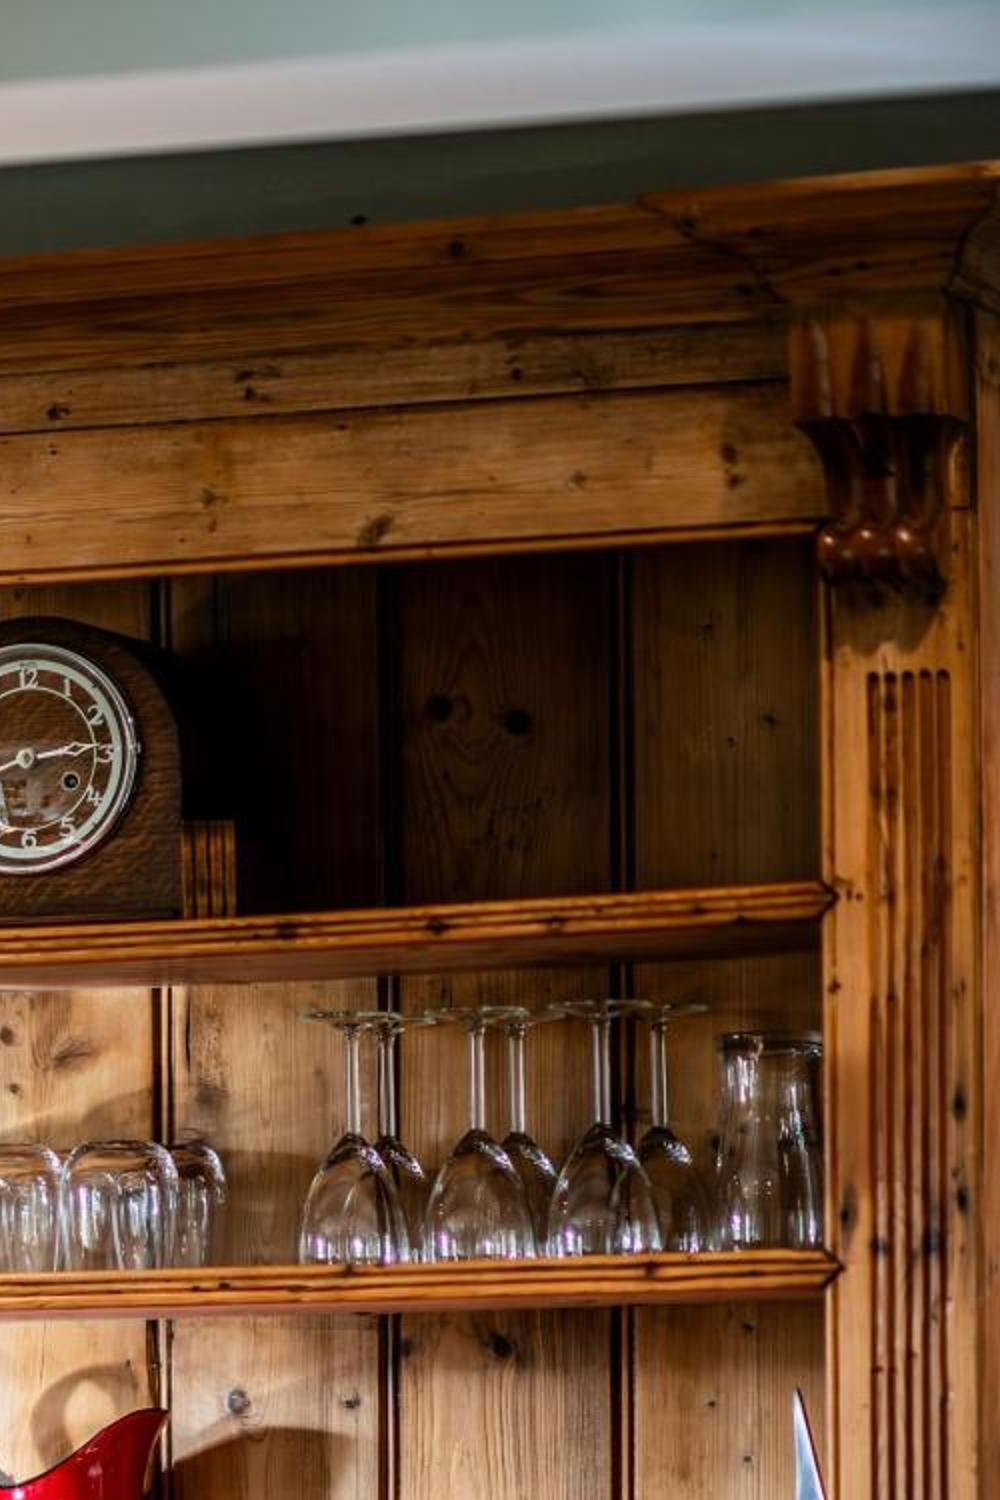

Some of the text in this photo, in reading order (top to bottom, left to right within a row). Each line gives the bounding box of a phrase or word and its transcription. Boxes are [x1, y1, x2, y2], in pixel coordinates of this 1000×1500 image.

[20, 667, 39, 689] 12
[64, 678, 72, 697] 1
[87, 705, 104, 725] 2
[96, 743, 114, 764] 3
[86, 784, 104, 807] 4
[59, 816, 76, 838] 5
[21, 829, 37, 849] 6
